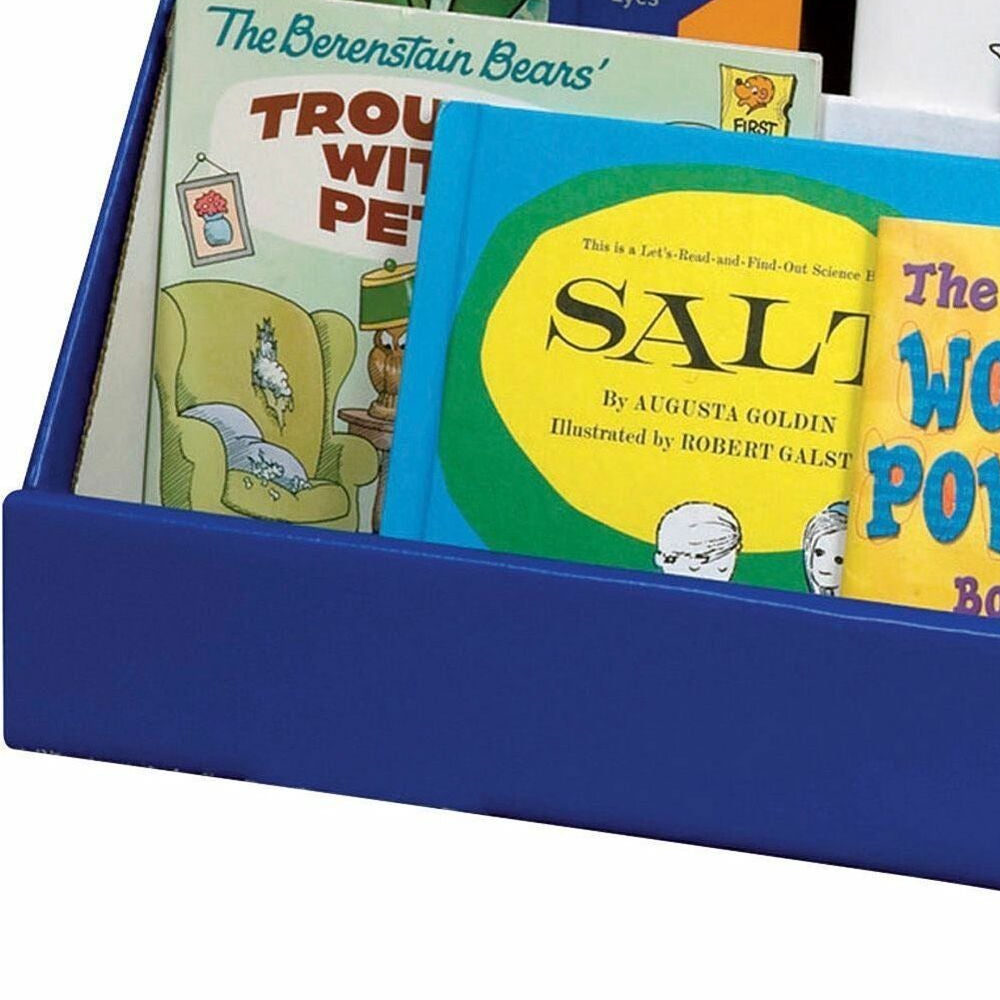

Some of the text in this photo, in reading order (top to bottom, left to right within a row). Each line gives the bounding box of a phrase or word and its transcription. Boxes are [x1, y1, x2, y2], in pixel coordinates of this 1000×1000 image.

[208, 4, 610, 91] The Berenstain Bears'
[732, 118, 778, 136] FIRST
[582, 238, 611, 253] This
[614, 241, 625, 255] is
[628, 246, 636, 255] a
[811, 264, 861, 282] Science
[903, 262, 999, 311] The
[602, 389, 837, 434] By AUGUSTA GOLDIN
[550, 417, 647, 445] Illustrated
[653, 430, 675, 452] by
[681, 433, 774, 460] ROBERT
